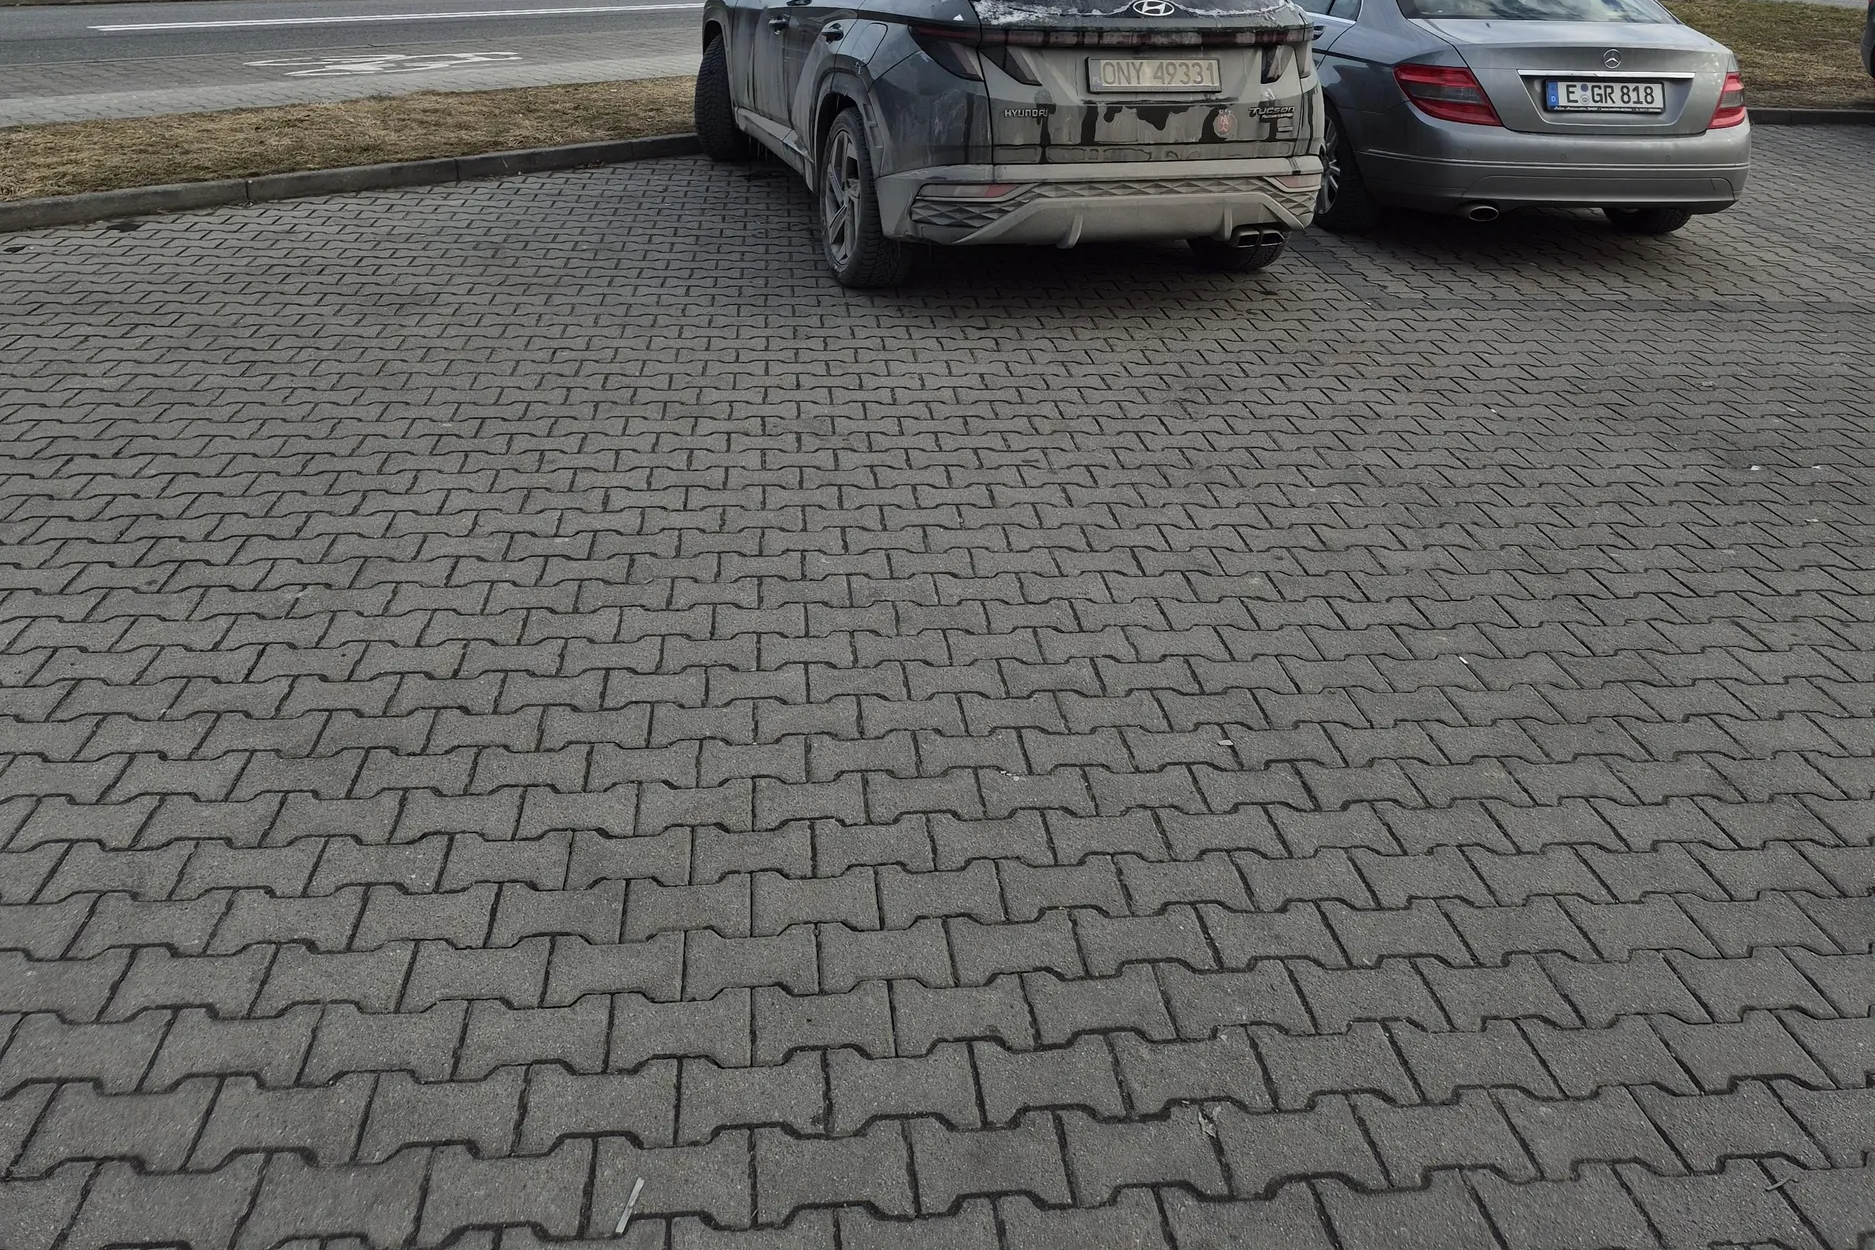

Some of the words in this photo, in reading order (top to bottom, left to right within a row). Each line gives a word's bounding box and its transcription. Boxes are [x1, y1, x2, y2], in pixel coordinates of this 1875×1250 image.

[1102, 61, 1144, 85] ONY
[1153, 61, 1215, 85] 49331
[1566, 84, 1578, 104] E
[1591, 85, 1616, 104] GR
[1620, 85, 1655, 105] 818
[1004, 109, 1048, 117] HYUNDAI
